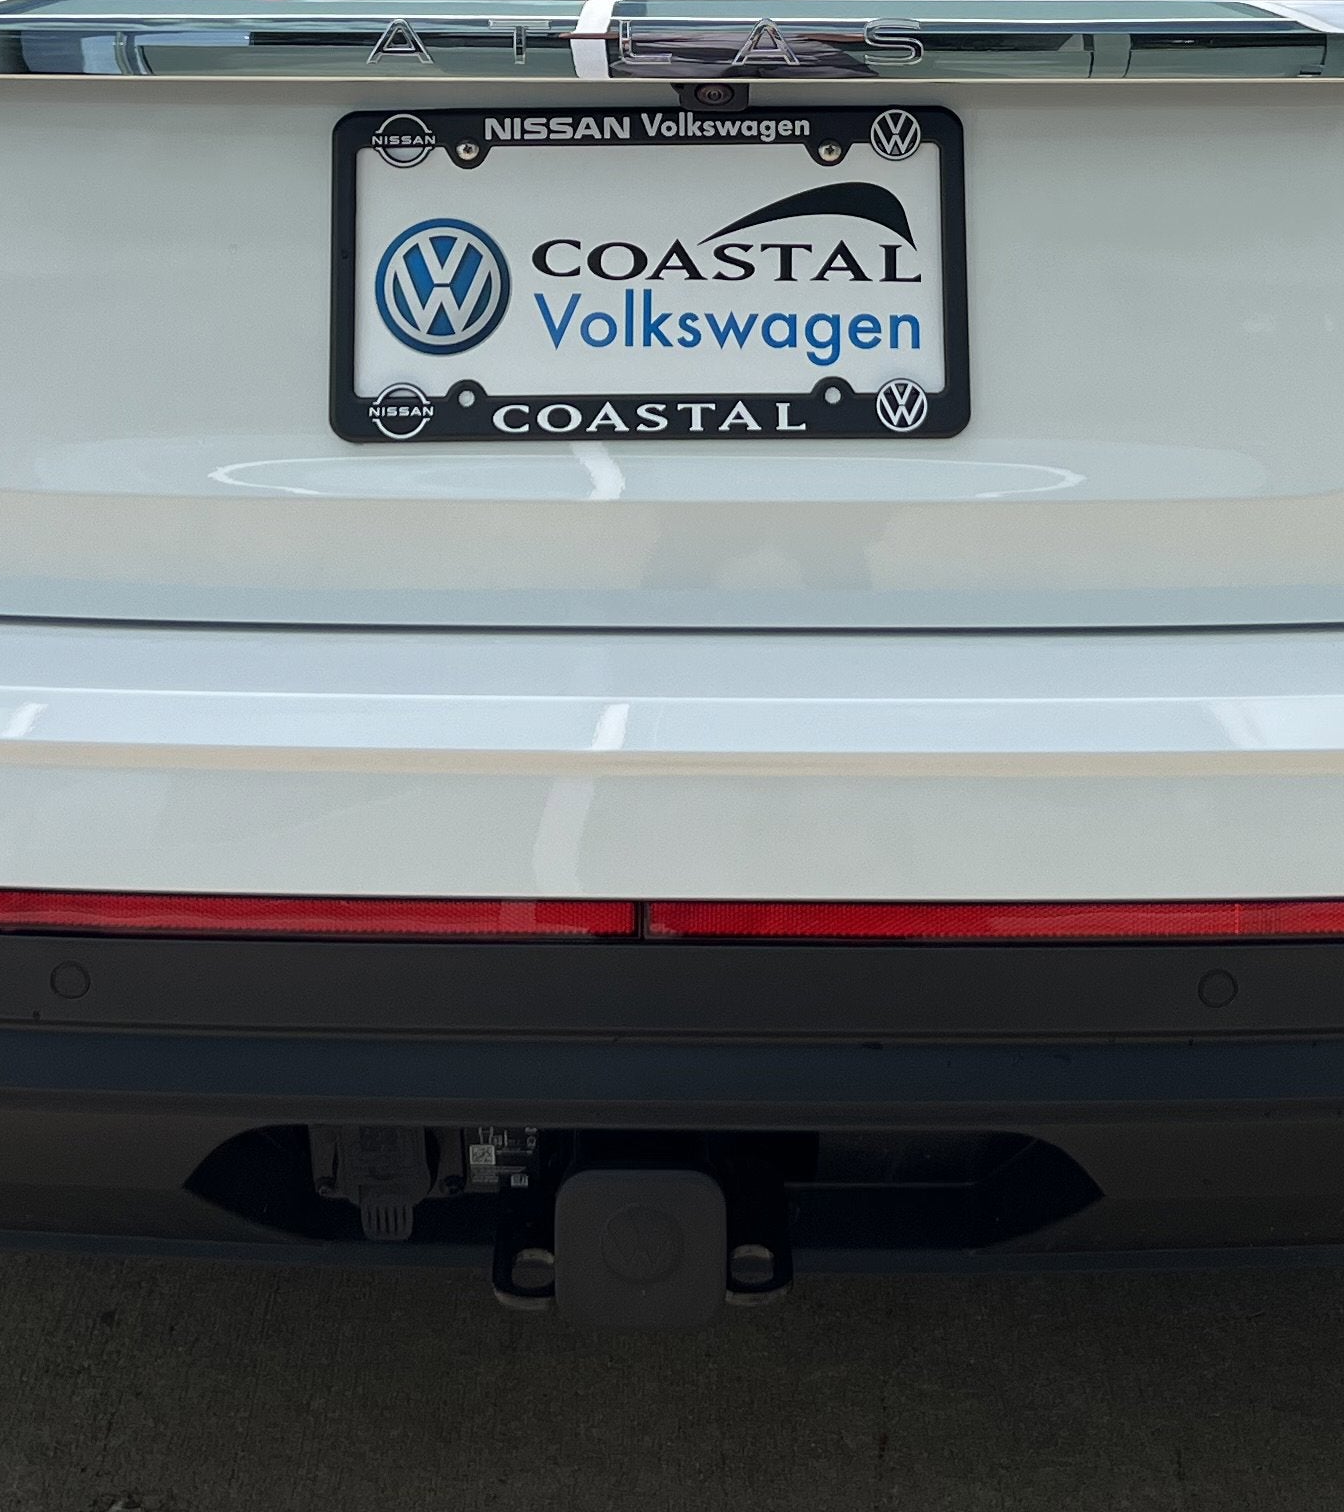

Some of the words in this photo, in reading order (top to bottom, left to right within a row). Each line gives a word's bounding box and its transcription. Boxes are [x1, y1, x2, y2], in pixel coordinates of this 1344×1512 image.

[366, 17, 926, 66] ATLAS
[370, 132, 436, 148] NISSAN
[483, 116, 632, 142] NISSAN
[640, 112, 812, 143] Volkswagen
[871, 110, 920, 159] VW
[531, 238, 923, 283] COASTAL
[384, 226, 504, 346] VW
[533, 288, 922, 367] Volkswagen
[367, 404, 435, 419] NISSAN
[492, 400, 808, 434] COASTAL
[877, 380, 926, 431] VW
